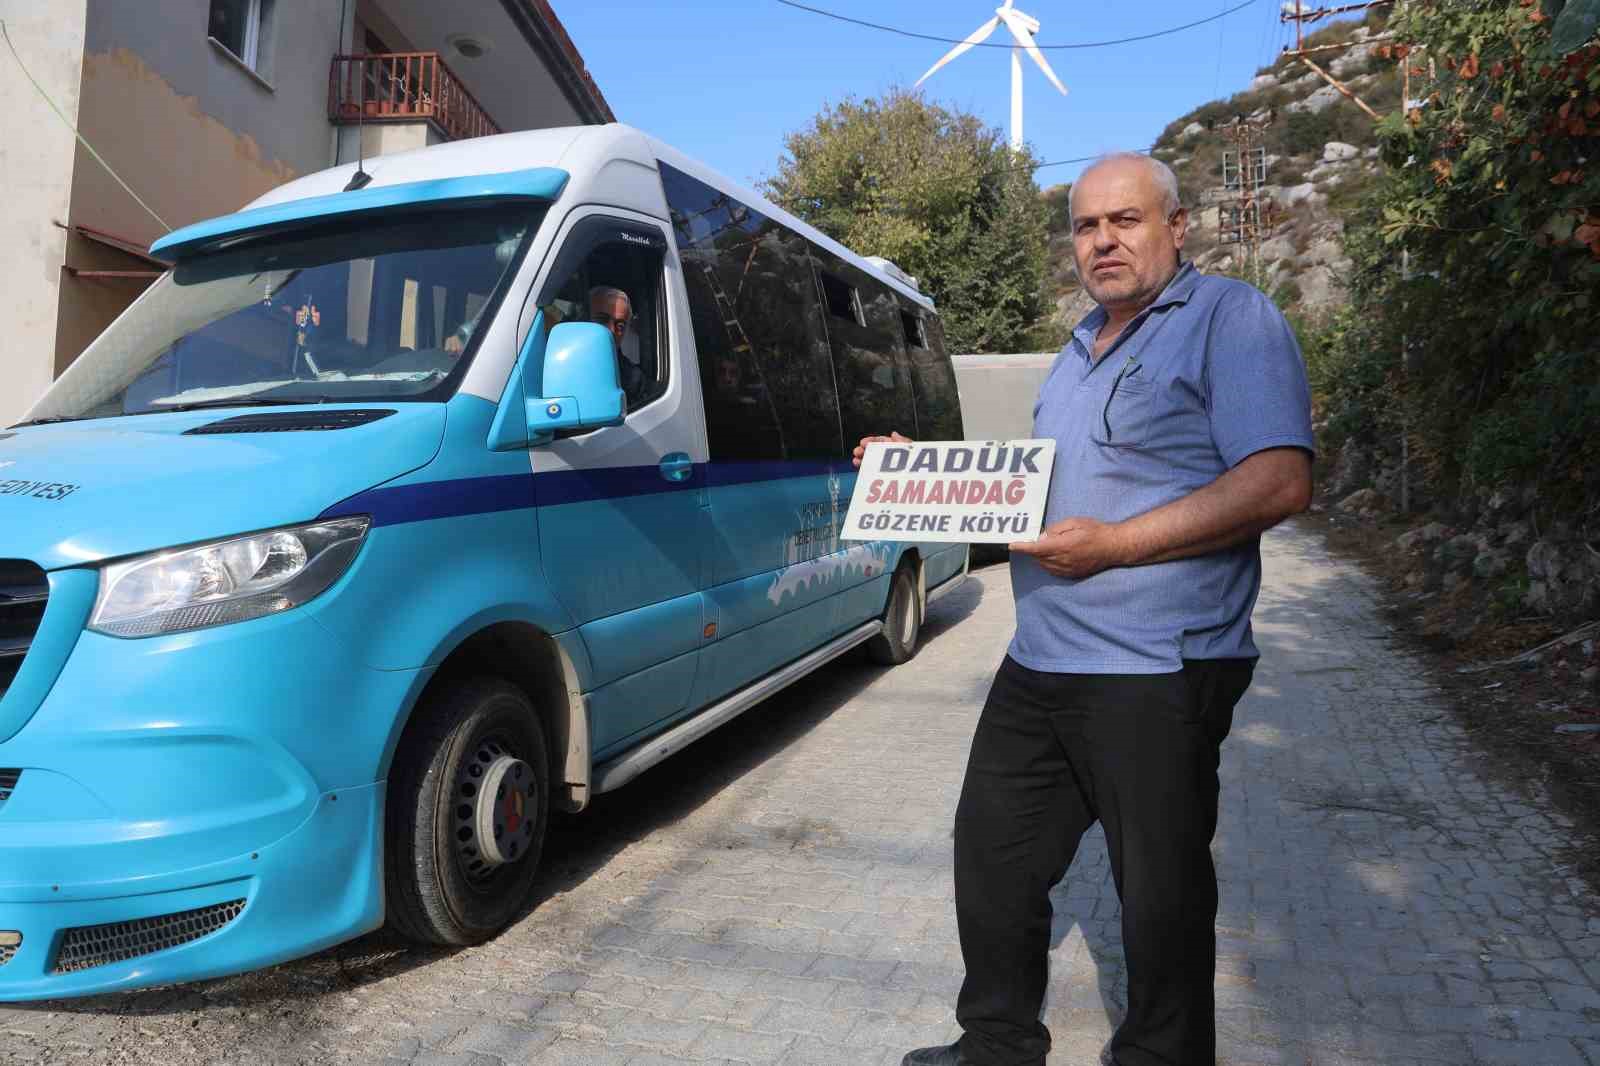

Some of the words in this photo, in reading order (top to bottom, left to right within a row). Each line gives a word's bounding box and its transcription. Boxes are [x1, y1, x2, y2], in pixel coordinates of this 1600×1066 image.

[880, 442, 1044, 473] DADÜK
[866, 474, 1026, 504] SAMANDAĞ
[858, 510, 951, 532] GÖZENE
[959, 512, 1029, 534] KÖYÜ
